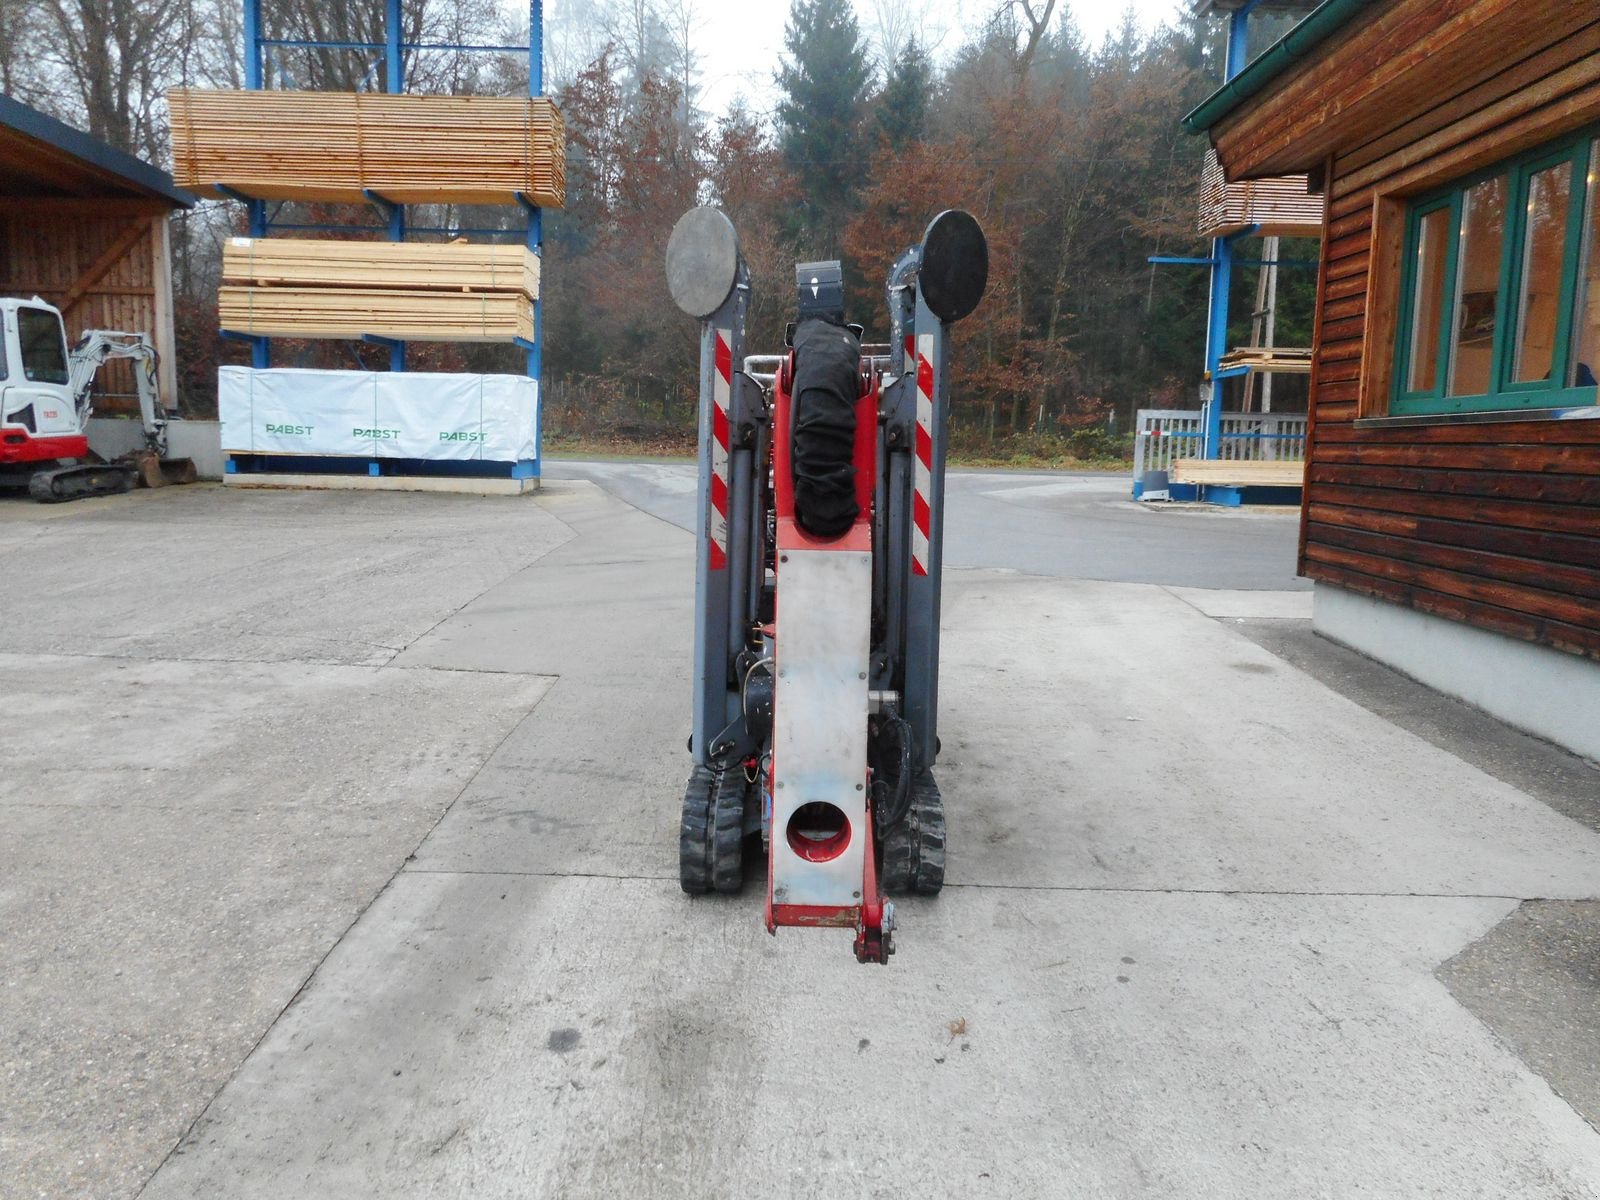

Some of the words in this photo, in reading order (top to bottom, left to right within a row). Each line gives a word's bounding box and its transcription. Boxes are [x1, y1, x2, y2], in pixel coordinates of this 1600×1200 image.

[266, 423, 314, 436] PABST
[352, 428, 401, 439] PABST
[439, 431, 488, 442] PABST
